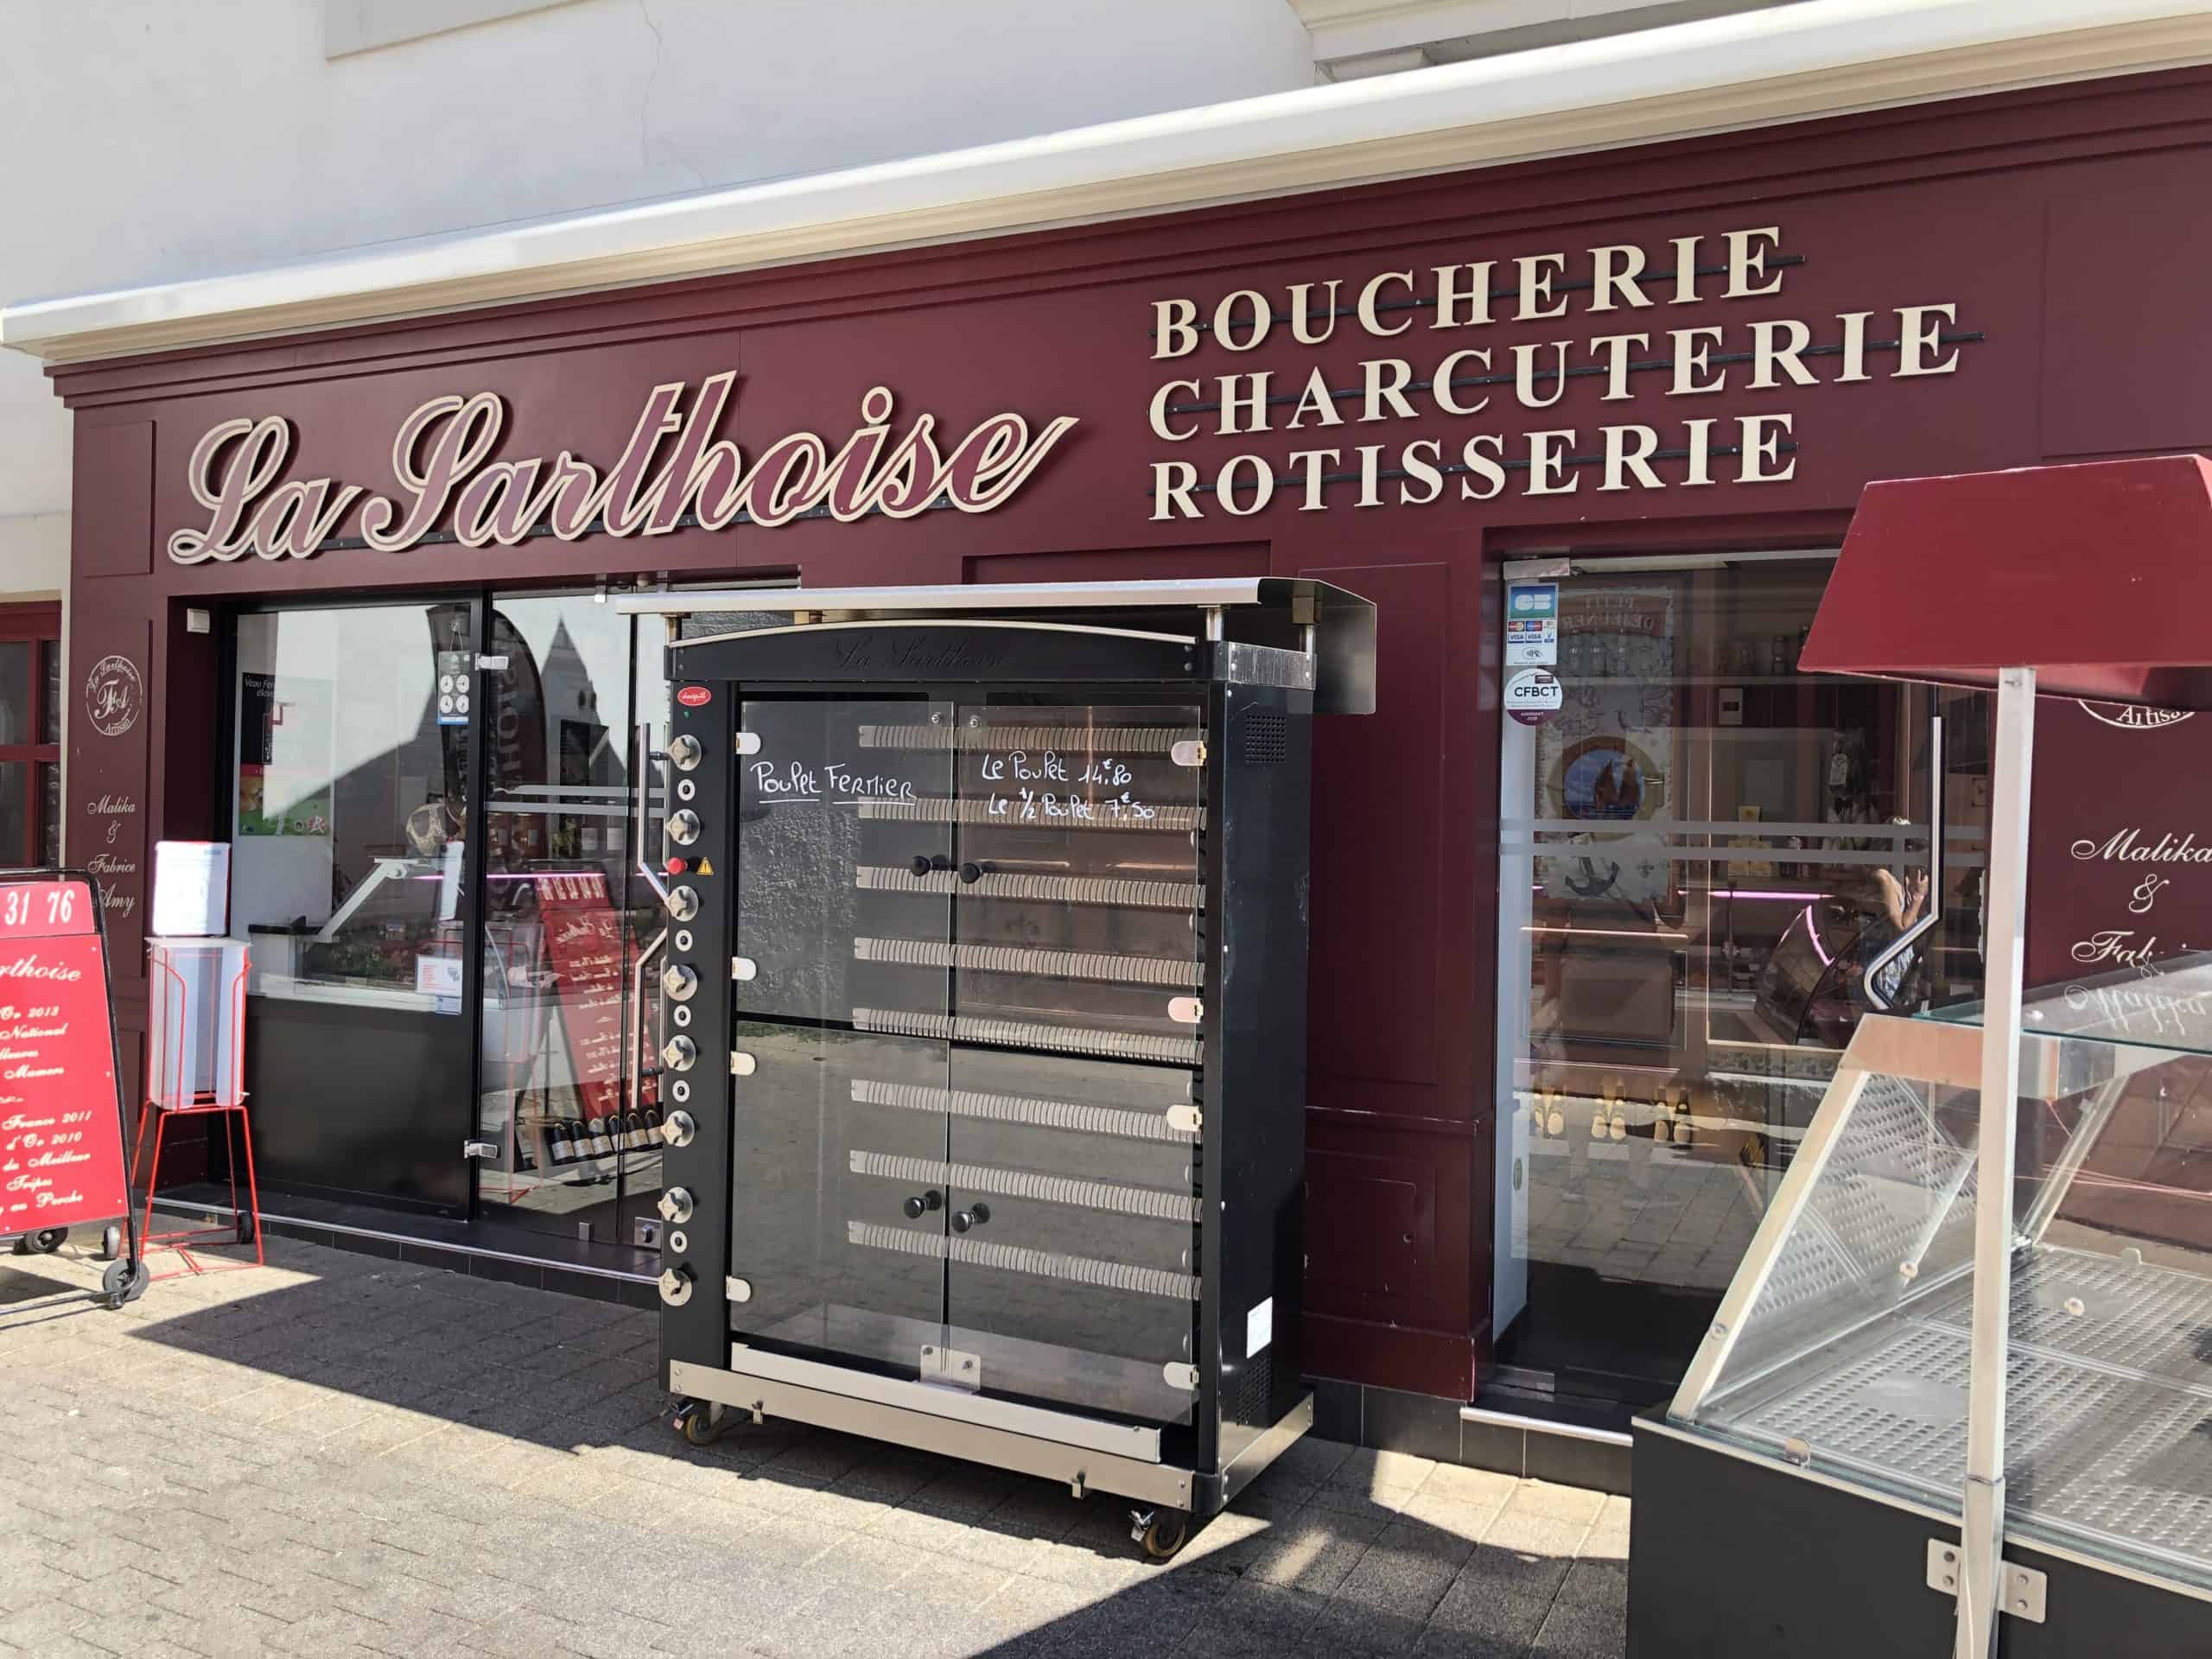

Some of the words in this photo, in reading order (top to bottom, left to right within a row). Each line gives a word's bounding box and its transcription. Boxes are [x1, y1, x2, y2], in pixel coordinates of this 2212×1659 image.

[1150, 226, 1783, 359] BOUCHERIE
[1147, 303, 1960, 442] CHARCUTERIE
[168, 416, 366, 566] La
[364, 372, 1078, 551] Sarthoise
[1149, 413, 1797, 521] ROTISSERIE
[1514, 686, 1559, 697] CFBCT
[982, 753, 1004, 779] Le
[87, 795, 137, 815] Malika
[988, 791, 1008, 815] Le
[106, 820, 121, 843] &
[2071, 828, 2212, 862] Malika
[88, 853, 136, 874] Fabrice
[4, 891, 30, 925] 31
[48, 889, 75, 924] 76
[99, 882, 136, 918] Amy
[2129, 873, 2170, 912] &
[51, 1131, 83, 1145] 2010
